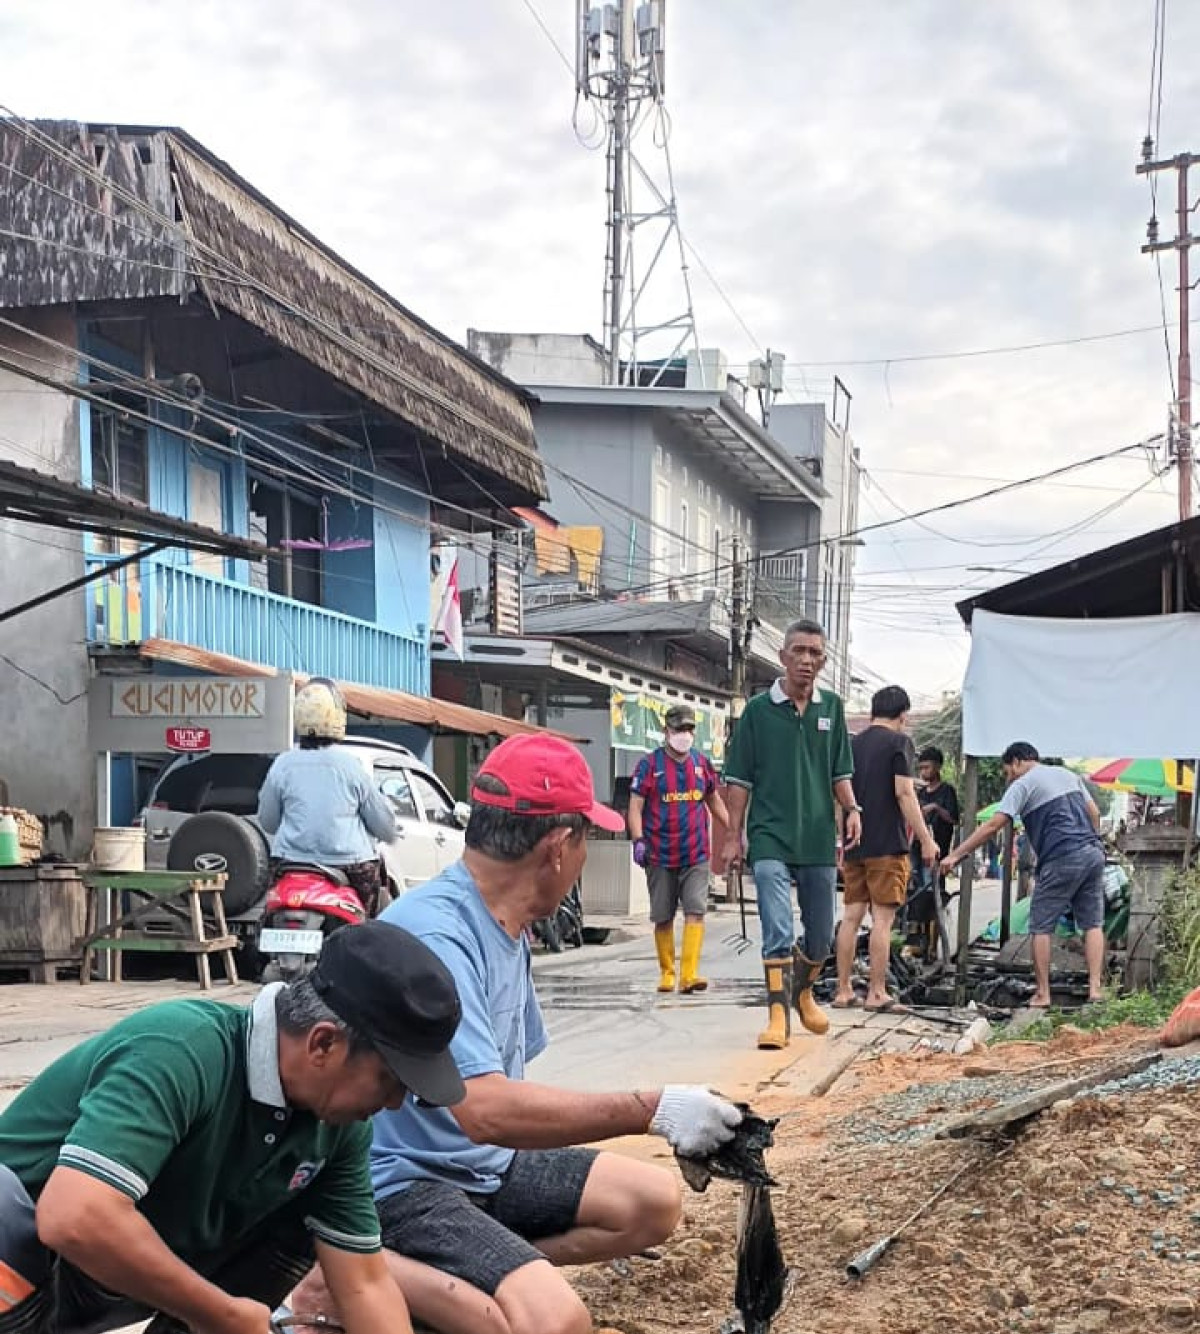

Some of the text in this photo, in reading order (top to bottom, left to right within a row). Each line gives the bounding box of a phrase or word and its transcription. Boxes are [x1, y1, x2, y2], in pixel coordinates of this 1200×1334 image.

[121, 683, 263, 716] CUCI MOTOR
[173, 729, 205, 741] TUTUP
